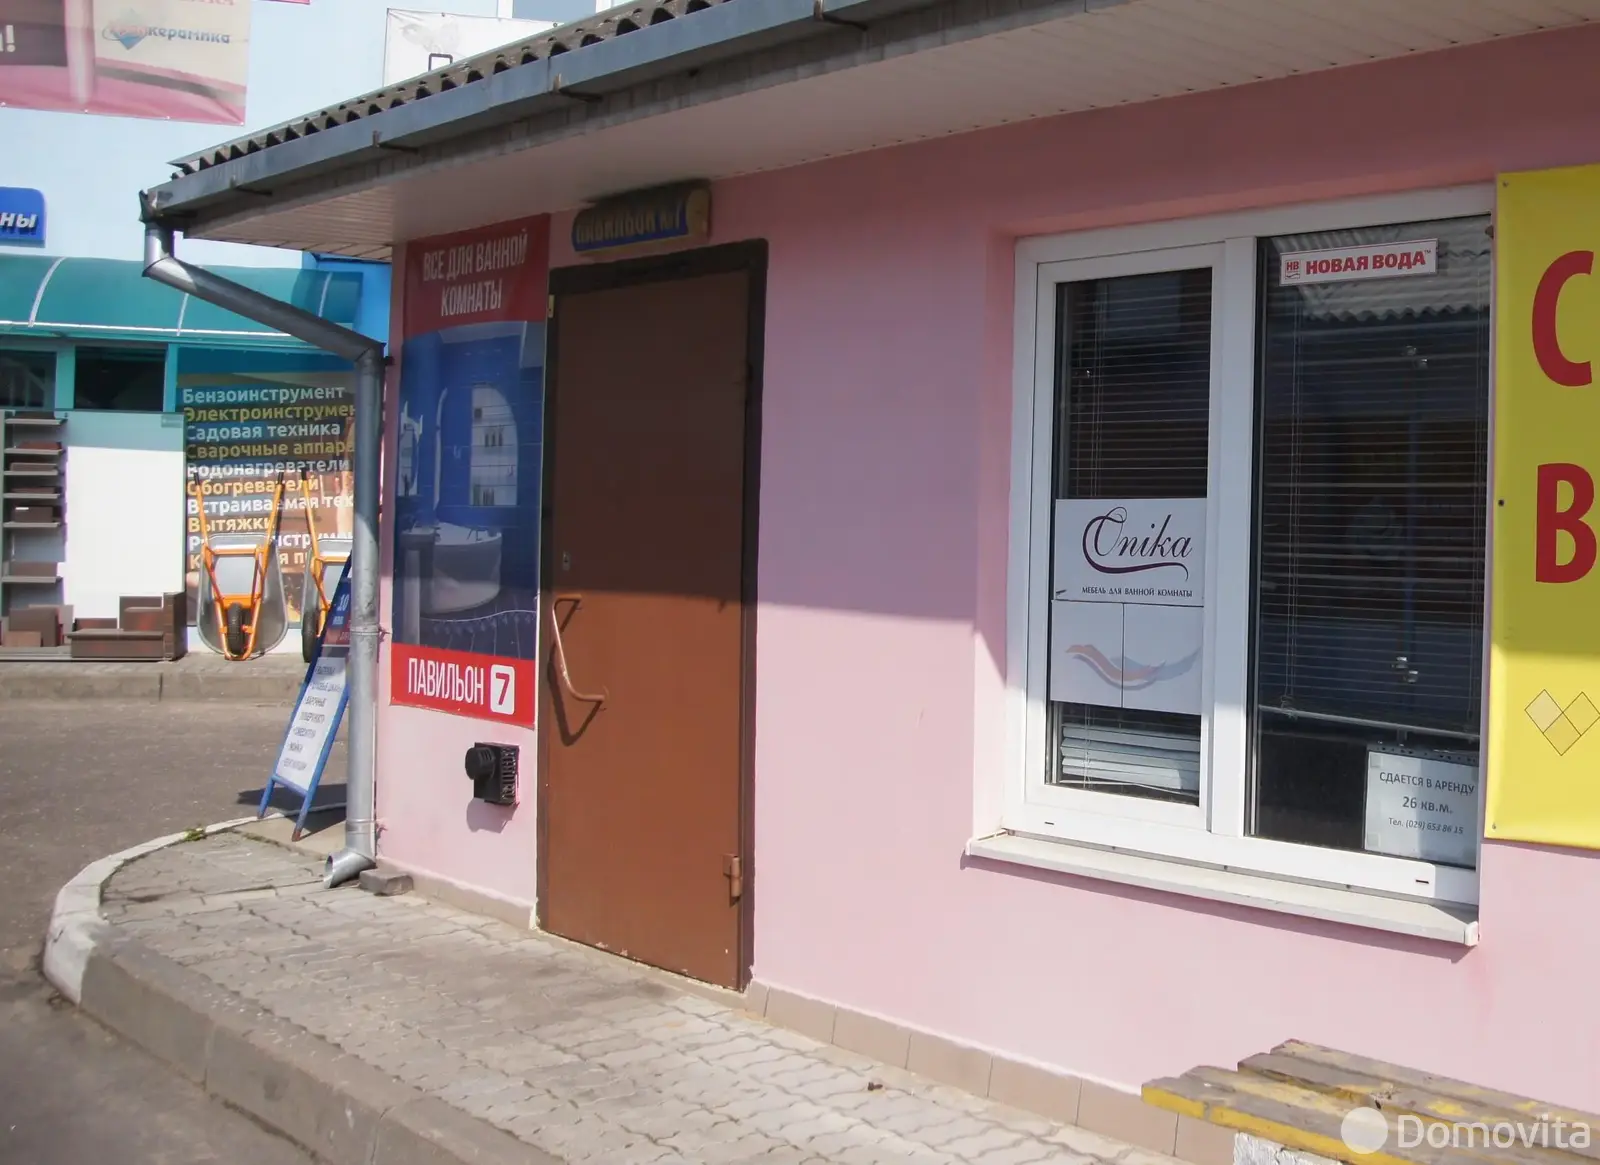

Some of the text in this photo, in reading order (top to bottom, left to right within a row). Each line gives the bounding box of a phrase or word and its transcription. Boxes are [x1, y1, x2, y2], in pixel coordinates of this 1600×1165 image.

[423, 230, 528, 282] ВСЕ ДЛЯ ВАННОЙ
[1305, 255, 1369, 275] НОВАЯ
[441, 280, 503, 317] КОМНАТЫ
[182, 386, 347, 405] Бензоинструмент
[187, 423, 341, 443] Садовая техника
[187, 445, 288, 463] Сварочные
[1082, 506, 1193, 582] Onika
[1082, 586, 1193, 598] МЕБЕЛЬ ДЛЯ ВАННОЙ КОМНАТЫ
[408, 657, 511, 706] ПАВИЛЬОН 7
[1379, 772, 1475, 795] СДАЕТСЯ В АРЕНДУ
[1402, 796, 1418, 809] 26
[1388, 817, 1404, 827] Тел.
[1405, 819, 1426, 831] (029)
